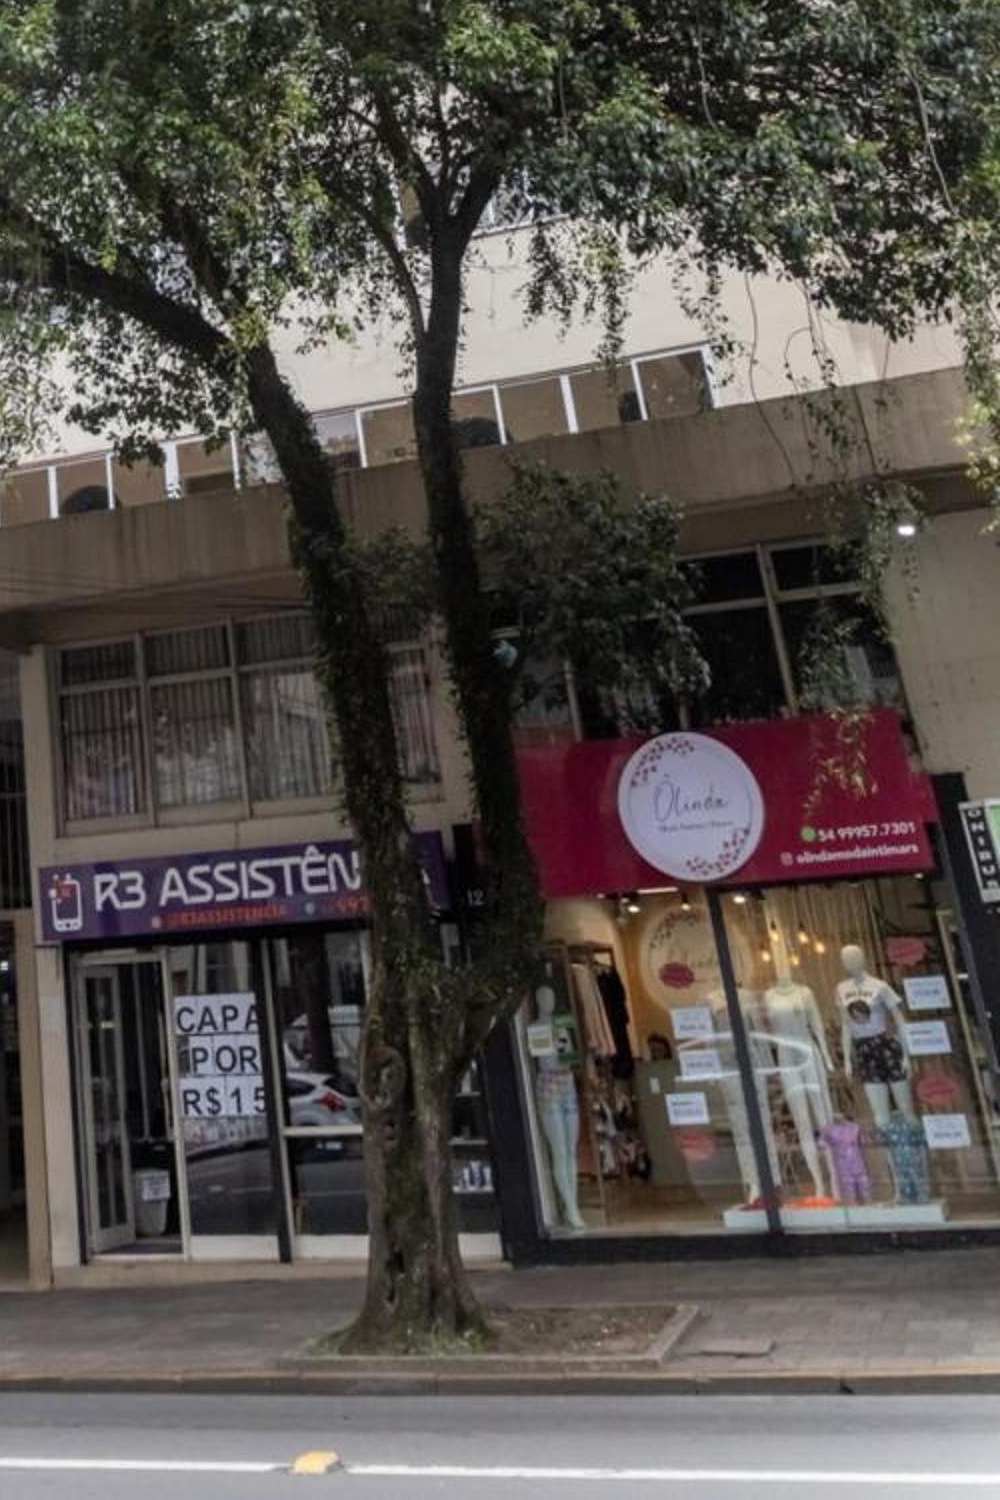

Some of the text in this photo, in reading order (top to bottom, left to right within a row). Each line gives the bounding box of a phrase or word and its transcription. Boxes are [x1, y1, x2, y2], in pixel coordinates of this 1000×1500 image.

[93, 870, 147, 911] R3
[159, 845, 362, 907] ASSISTÊN
[191, 1045, 260, 1074] POR
